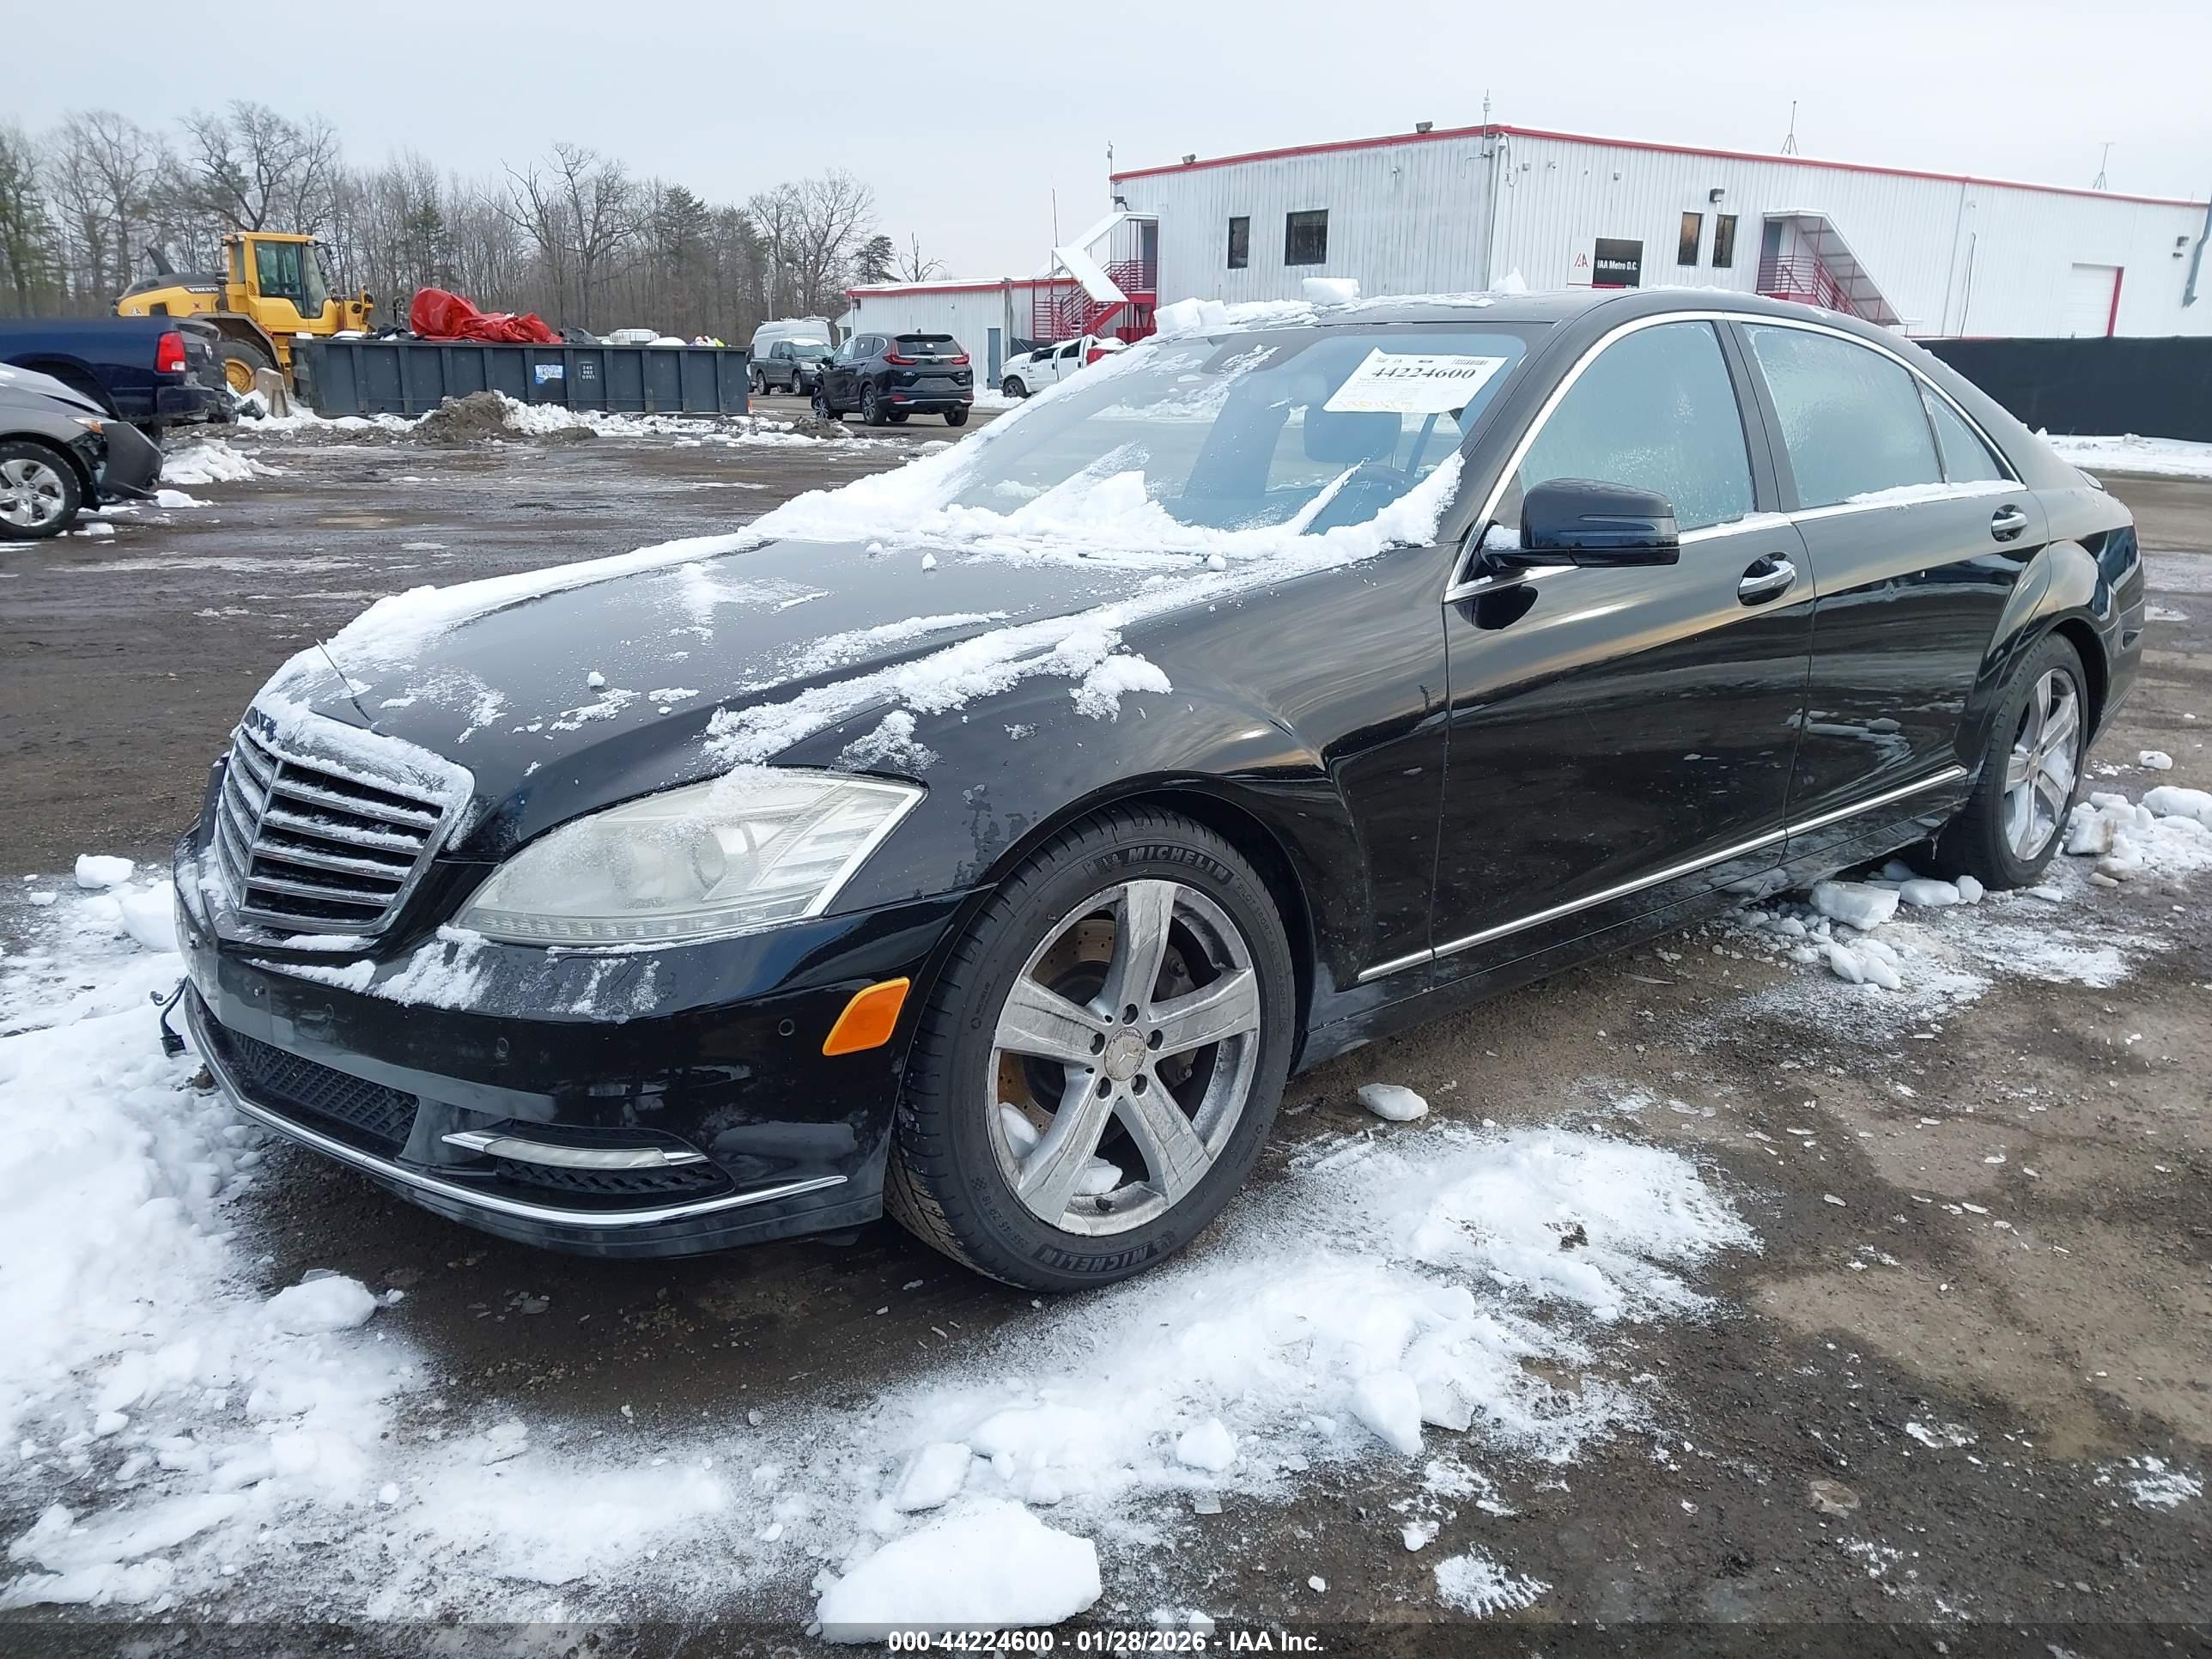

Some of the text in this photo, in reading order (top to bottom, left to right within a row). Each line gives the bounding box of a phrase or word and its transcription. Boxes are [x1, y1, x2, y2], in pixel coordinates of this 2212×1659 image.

[1597, 258, 1638, 270] IAA Metro D.C.
[1372, 367, 1476, 379] 44224600
[1128, 846, 1231, 882] MICHELIN
[1039, 1245, 1149, 1273] MICHELIN
